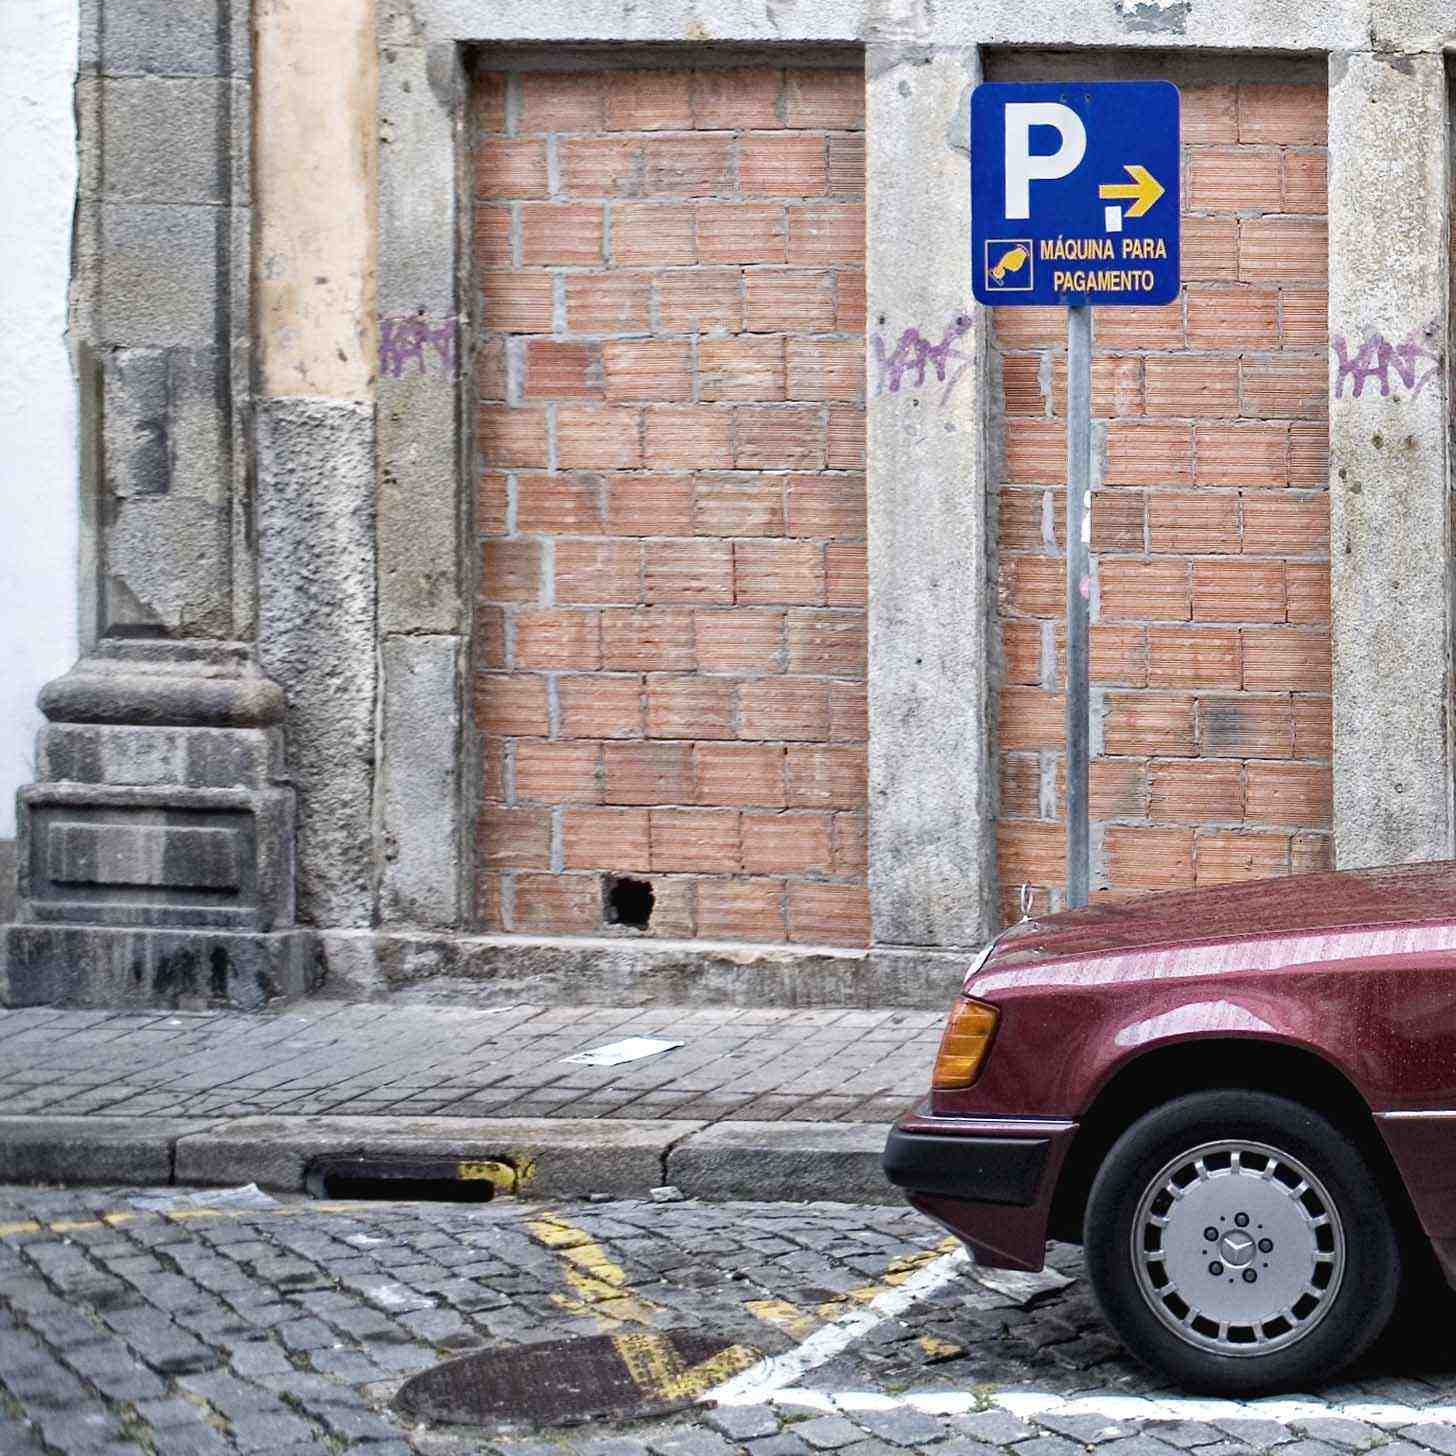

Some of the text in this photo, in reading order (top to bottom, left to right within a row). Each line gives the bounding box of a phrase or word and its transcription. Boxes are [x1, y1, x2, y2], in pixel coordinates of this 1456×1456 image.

[1004, 102, 1088, 220] P
[1039, 235, 1168, 261] MÁQUINA PARA
[1053, 269, 1155, 293] PAGAMENTO
